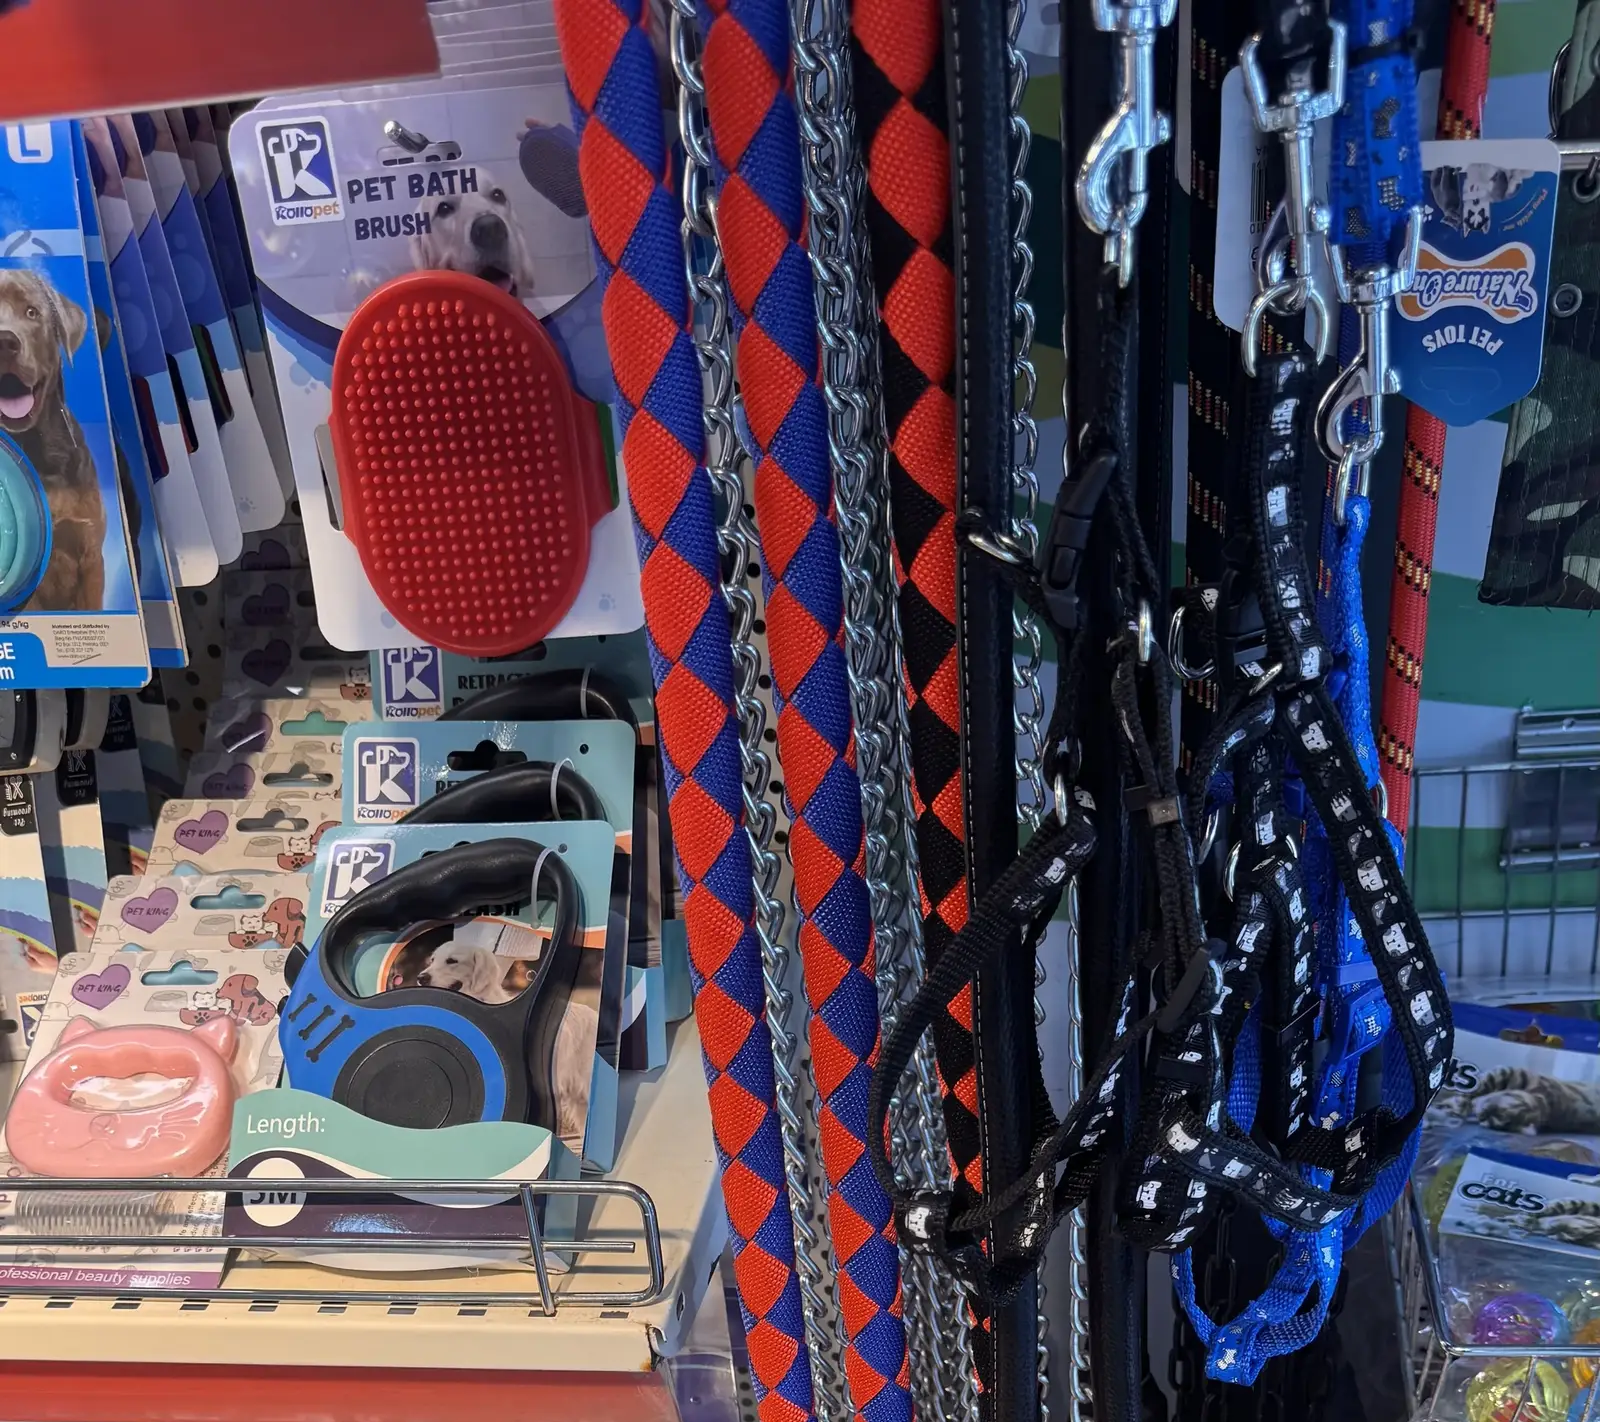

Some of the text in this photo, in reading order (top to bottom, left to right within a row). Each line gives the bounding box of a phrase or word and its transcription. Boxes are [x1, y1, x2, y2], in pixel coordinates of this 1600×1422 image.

[346, 167, 478, 204] PET BATH
[354, 211, 432, 241] BRUSH
[1404, 270, 1533, 313] NatureOn
[1421, 324, 1505, 356] PET TOYS
[179, 829, 221, 838] PET KING
[126, 907, 169, 916] PET KING
[77, 984, 122, 993] PET KING
[247, 1112, 326, 1138] Length:
[1461, 1182, 1545, 1212] cats
[75, 1270, 127, 1286] beauty
[129, 1272, 192, 1287] supplies
